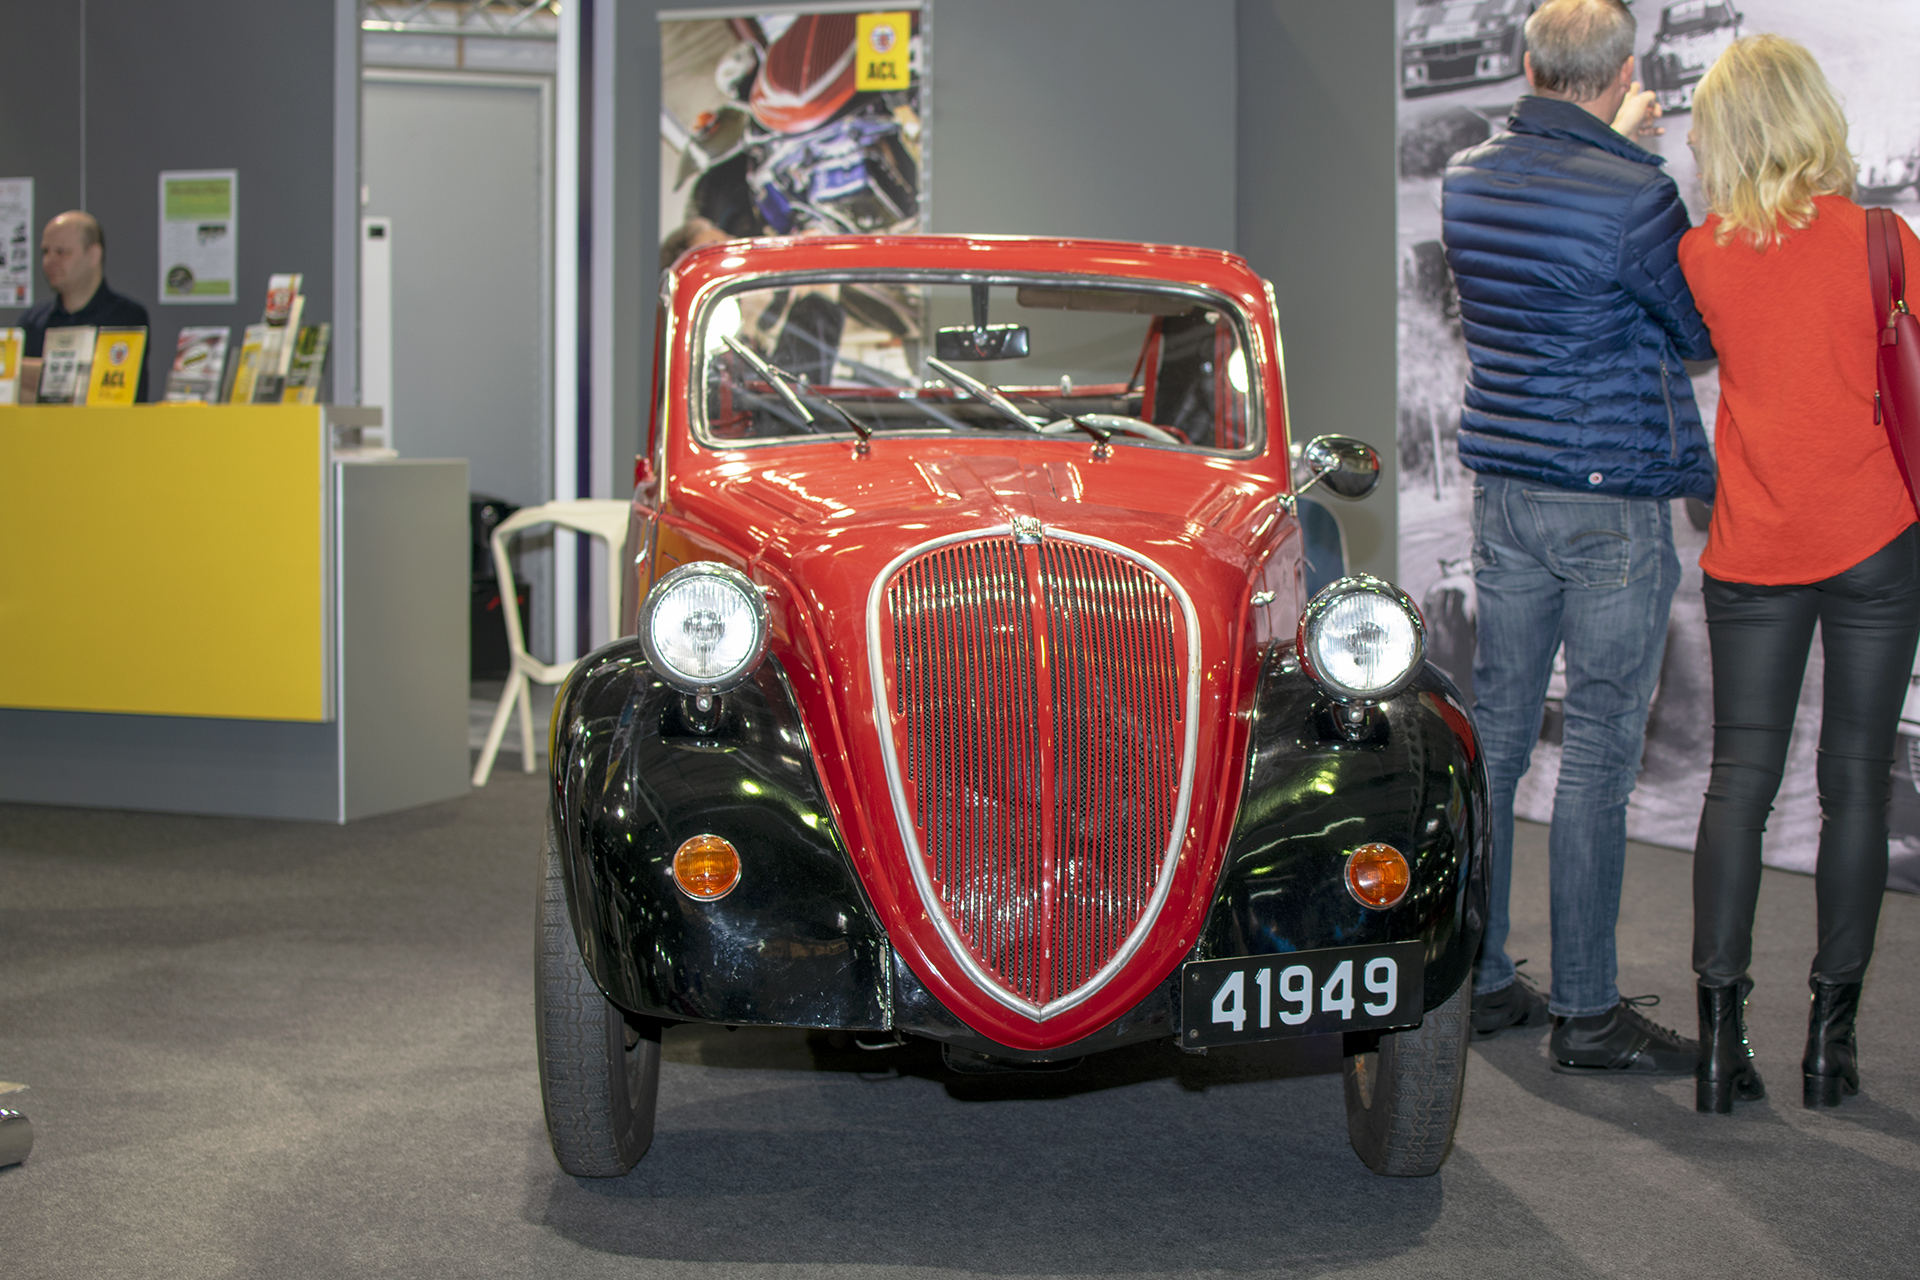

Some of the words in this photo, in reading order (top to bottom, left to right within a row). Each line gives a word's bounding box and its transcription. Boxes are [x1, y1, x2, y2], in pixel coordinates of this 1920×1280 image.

[867, 61, 897, 80] ACL
[101, 370, 125, 388] ACL
[1211, 957, 1398, 1031] 41949
